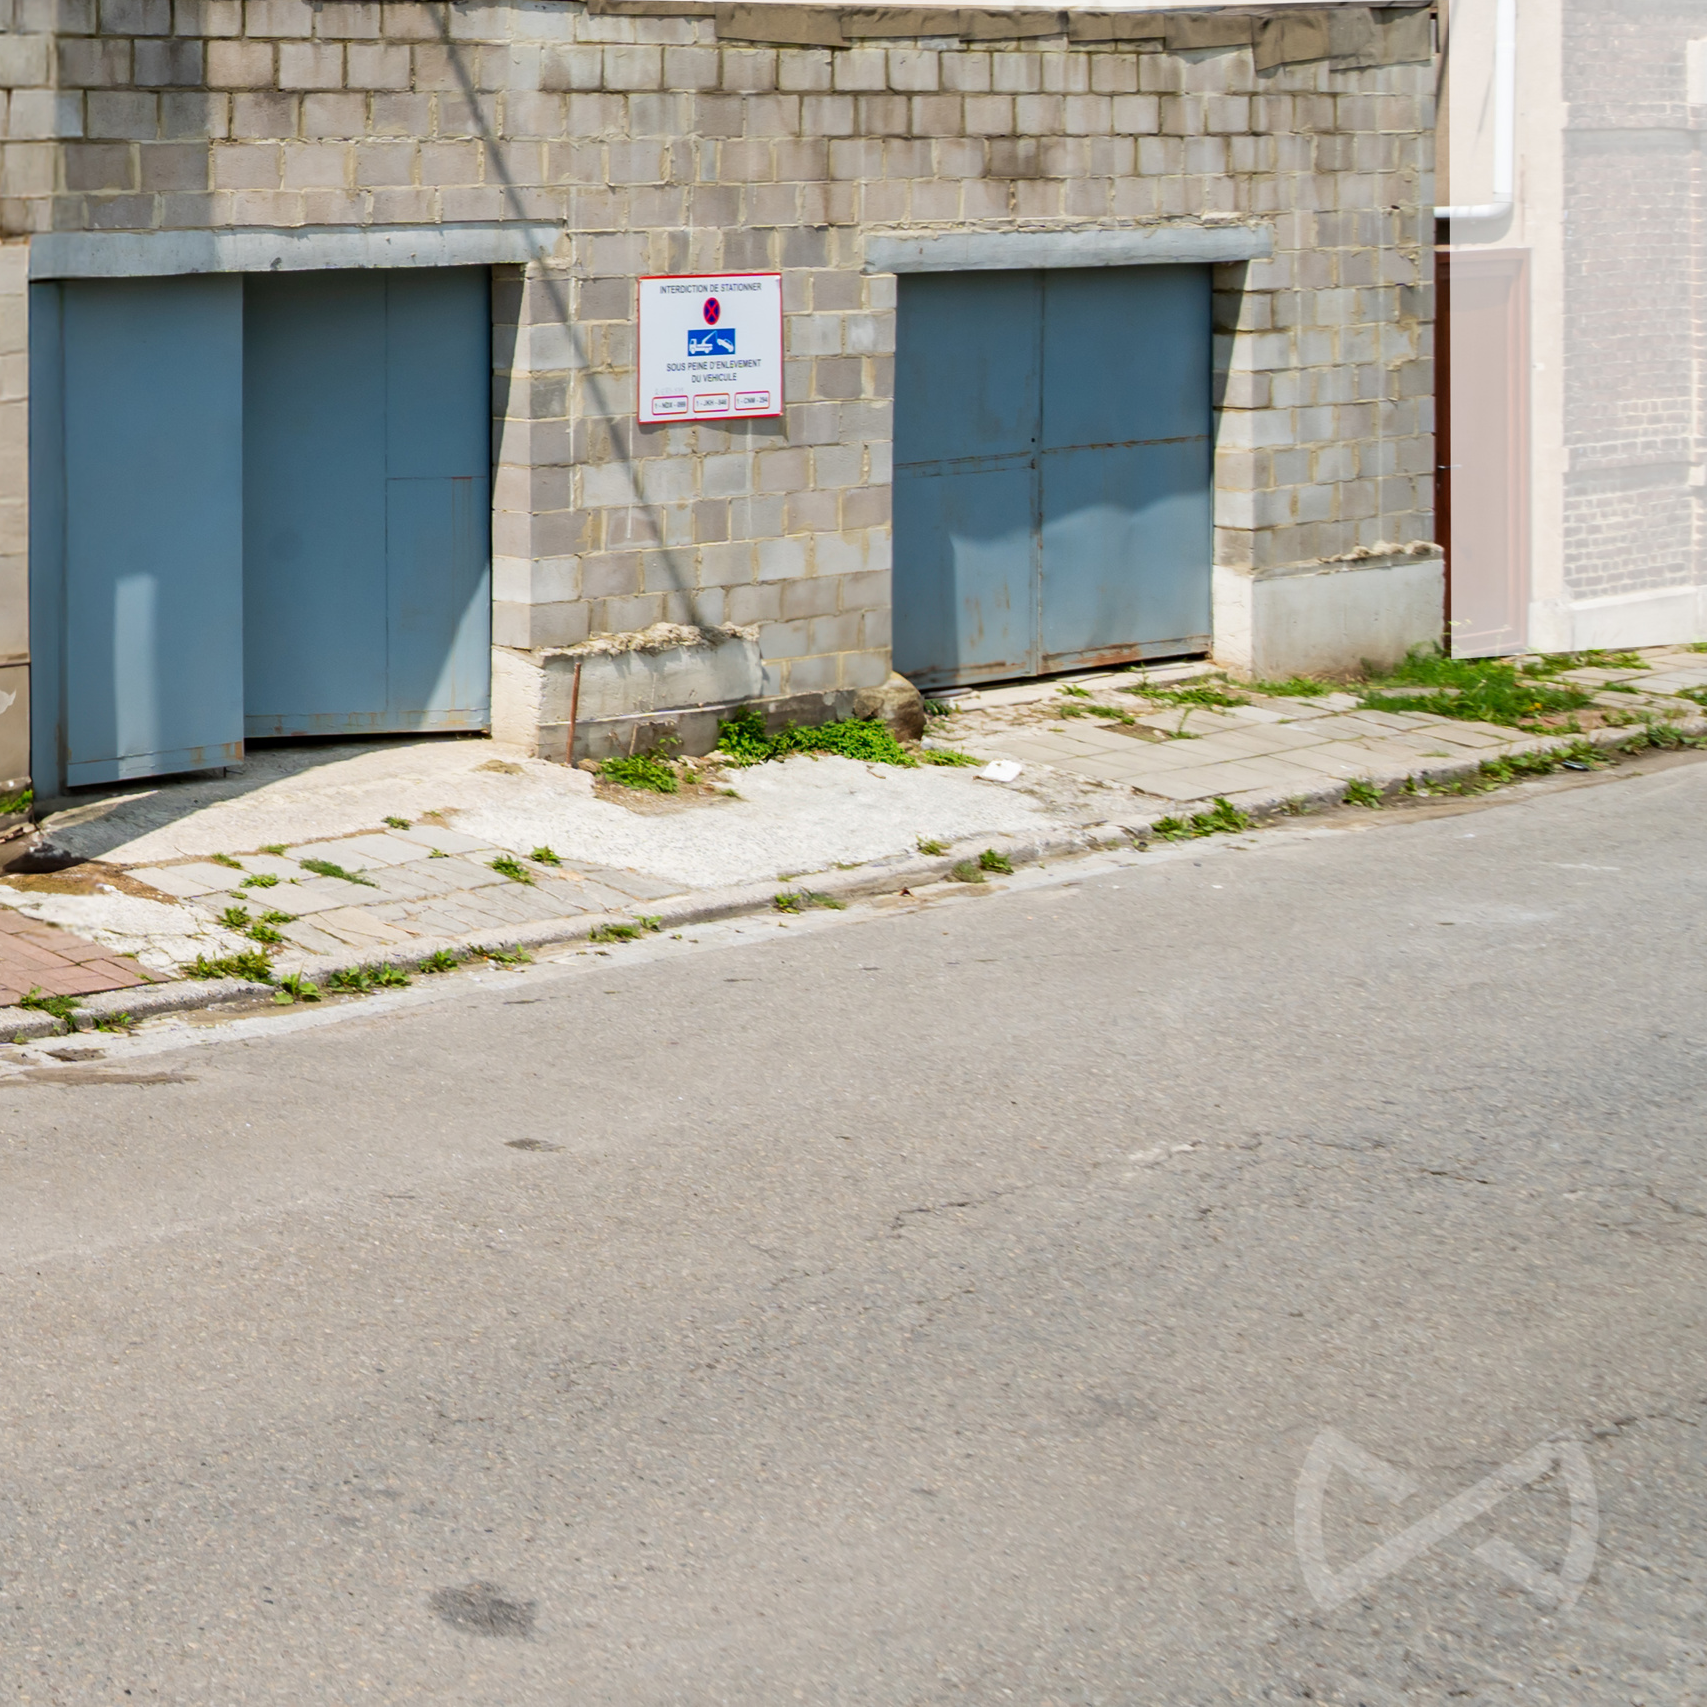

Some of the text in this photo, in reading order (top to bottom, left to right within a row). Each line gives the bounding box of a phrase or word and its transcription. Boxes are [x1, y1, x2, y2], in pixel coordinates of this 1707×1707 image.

[659, 282, 762, 294] INTERDICTION DE STATIONNER
[666, 359, 762, 372] SOUS PEINE D'ENLEVEMENT
[691, 373, 738, 384] DU VEHICULE
